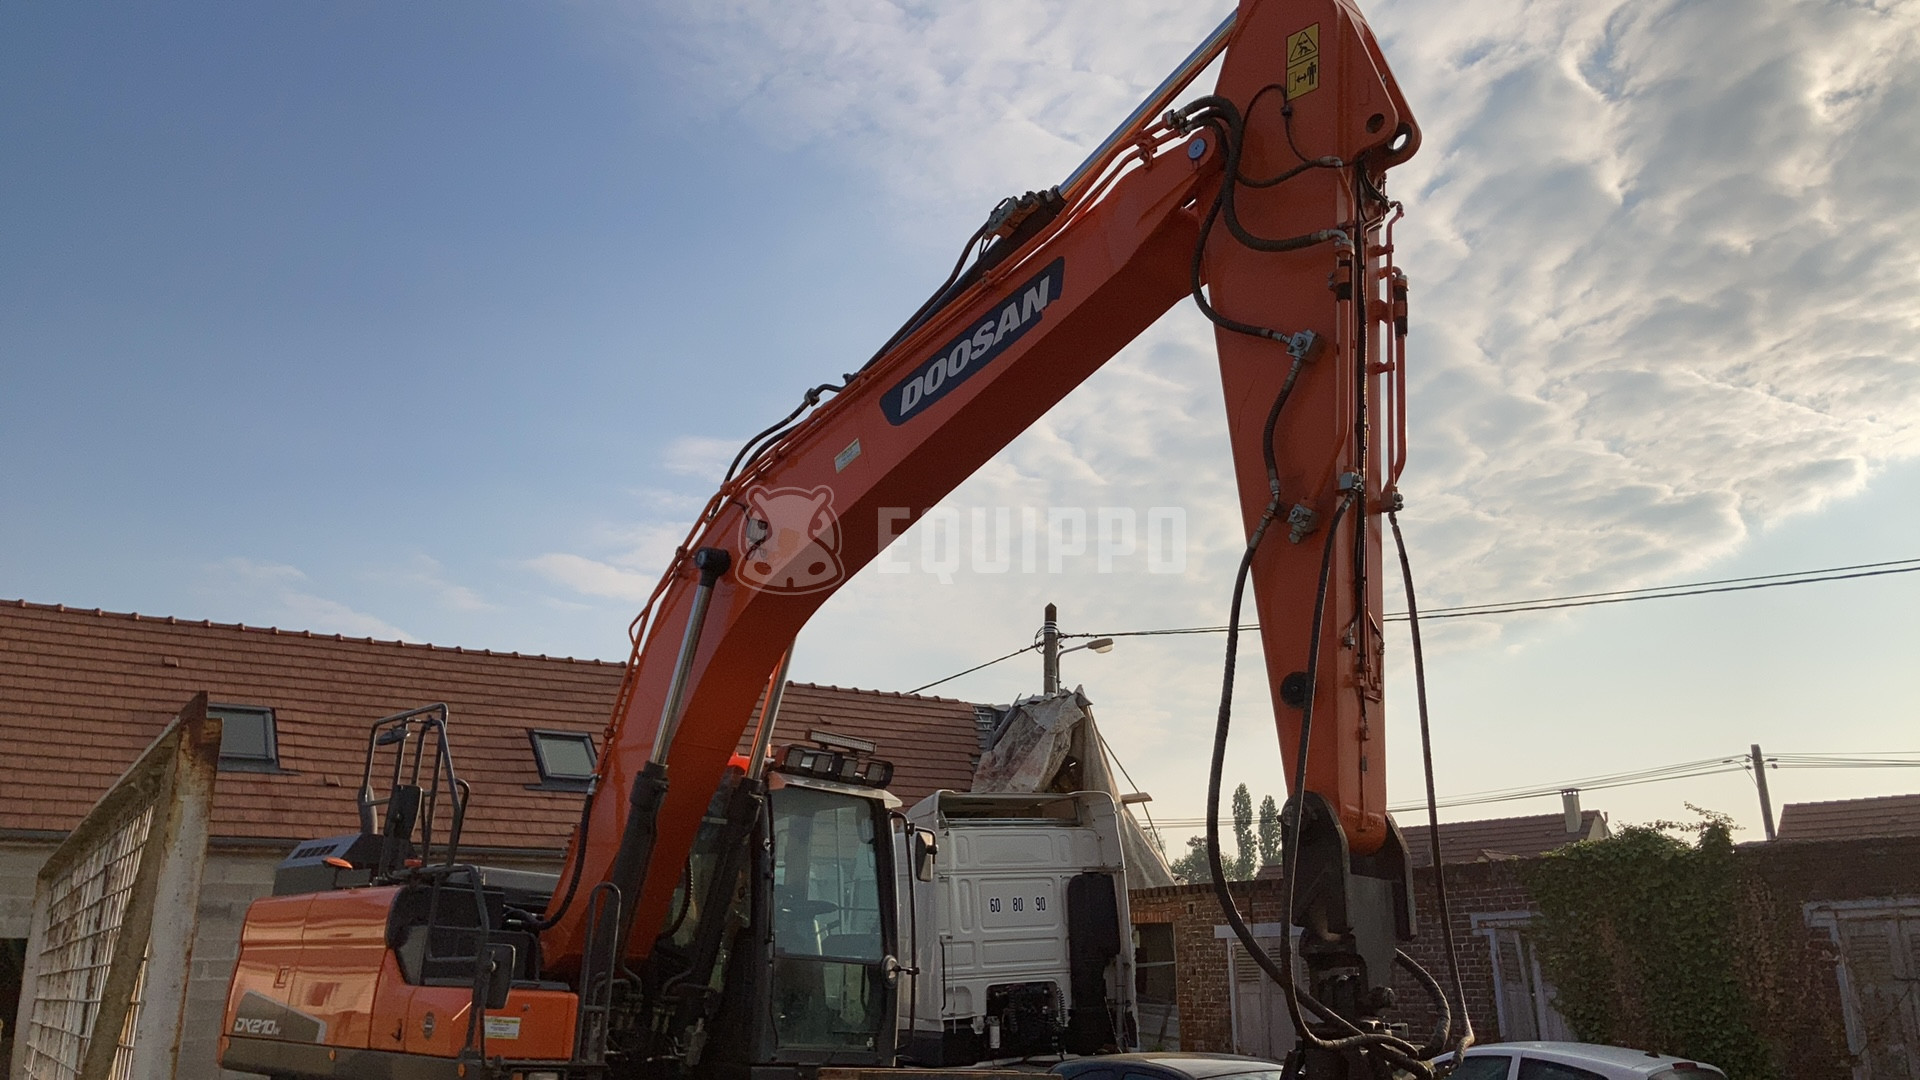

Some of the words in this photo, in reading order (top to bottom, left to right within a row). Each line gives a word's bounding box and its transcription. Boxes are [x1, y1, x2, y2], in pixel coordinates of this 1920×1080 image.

[900, 275, 1050, 416] DOOSAN
[989, 897, 1001, 913] 60
[1012, 897, 1024, 912] 80
[1035, 896, 1047, 911] 90
